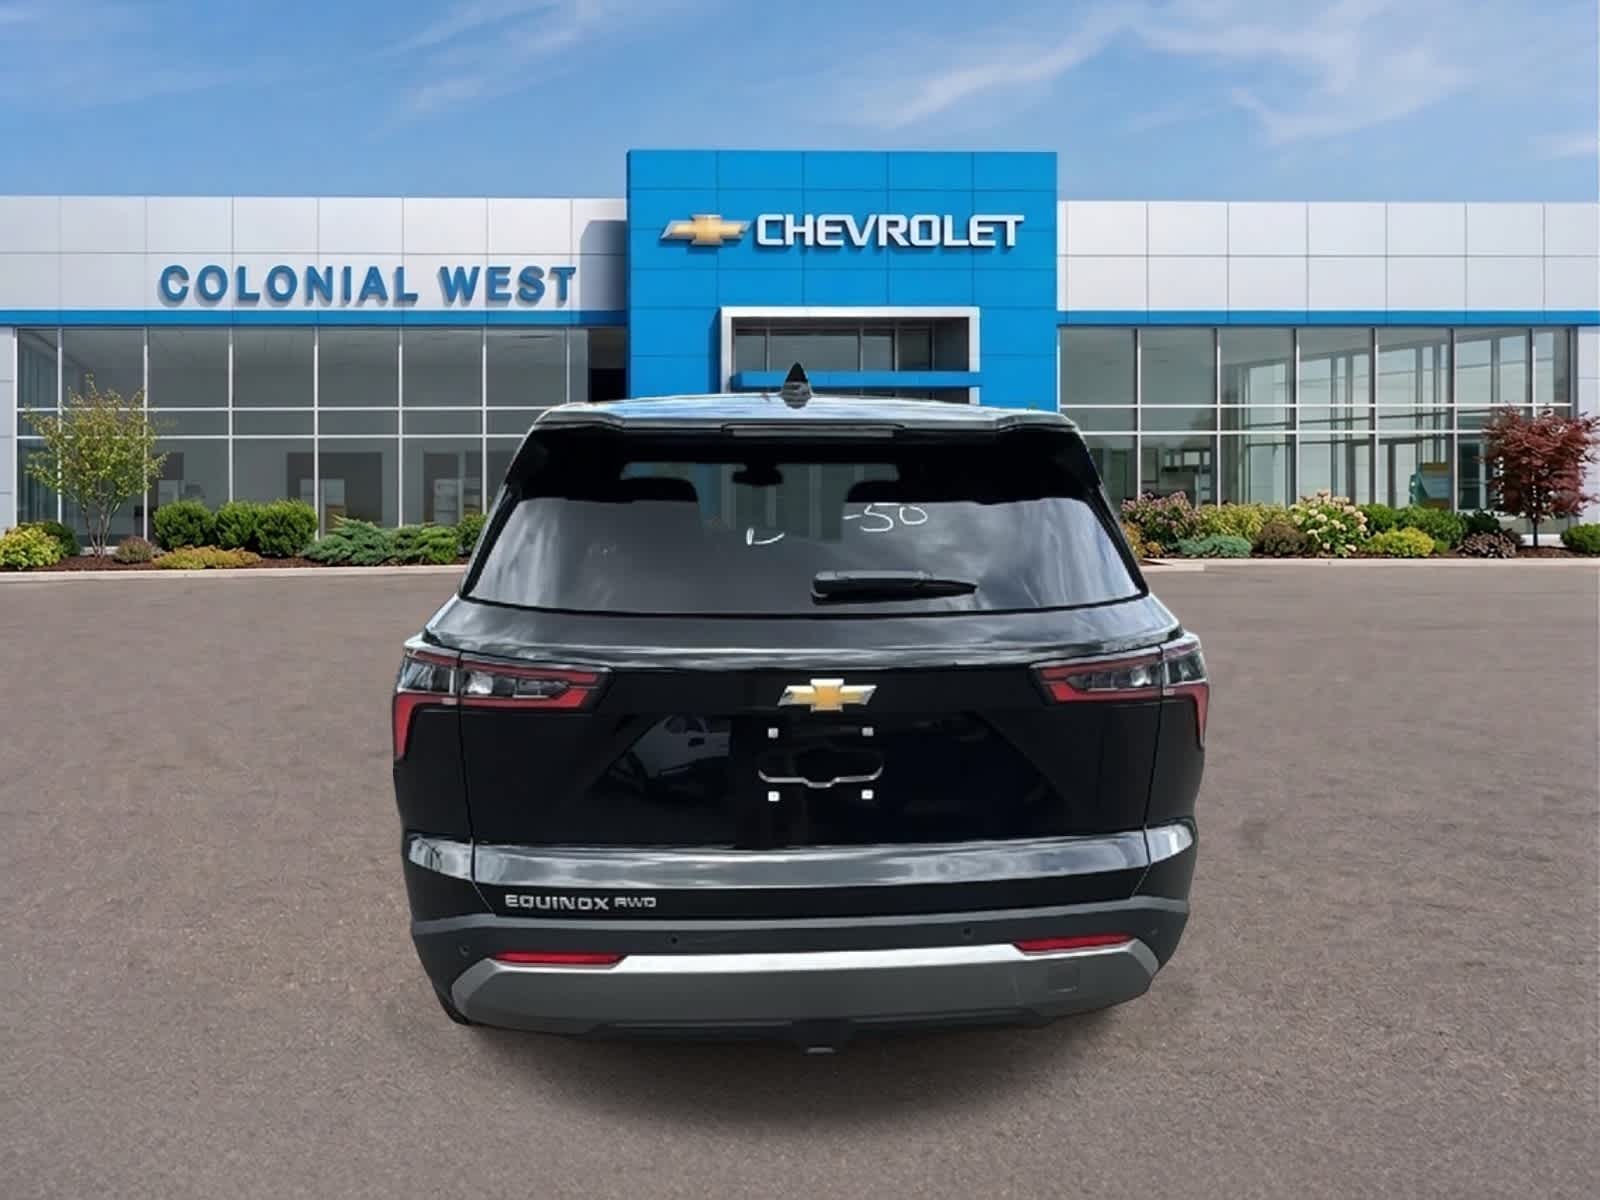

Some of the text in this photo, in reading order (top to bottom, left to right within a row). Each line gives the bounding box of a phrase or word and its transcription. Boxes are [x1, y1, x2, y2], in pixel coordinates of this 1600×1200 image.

[757, 213, 1025, 247] CHEVROLET
[159, 264, 577, 304] COLONIAL WEST
[504, 894, 657, 911] EQUINOX AWD
